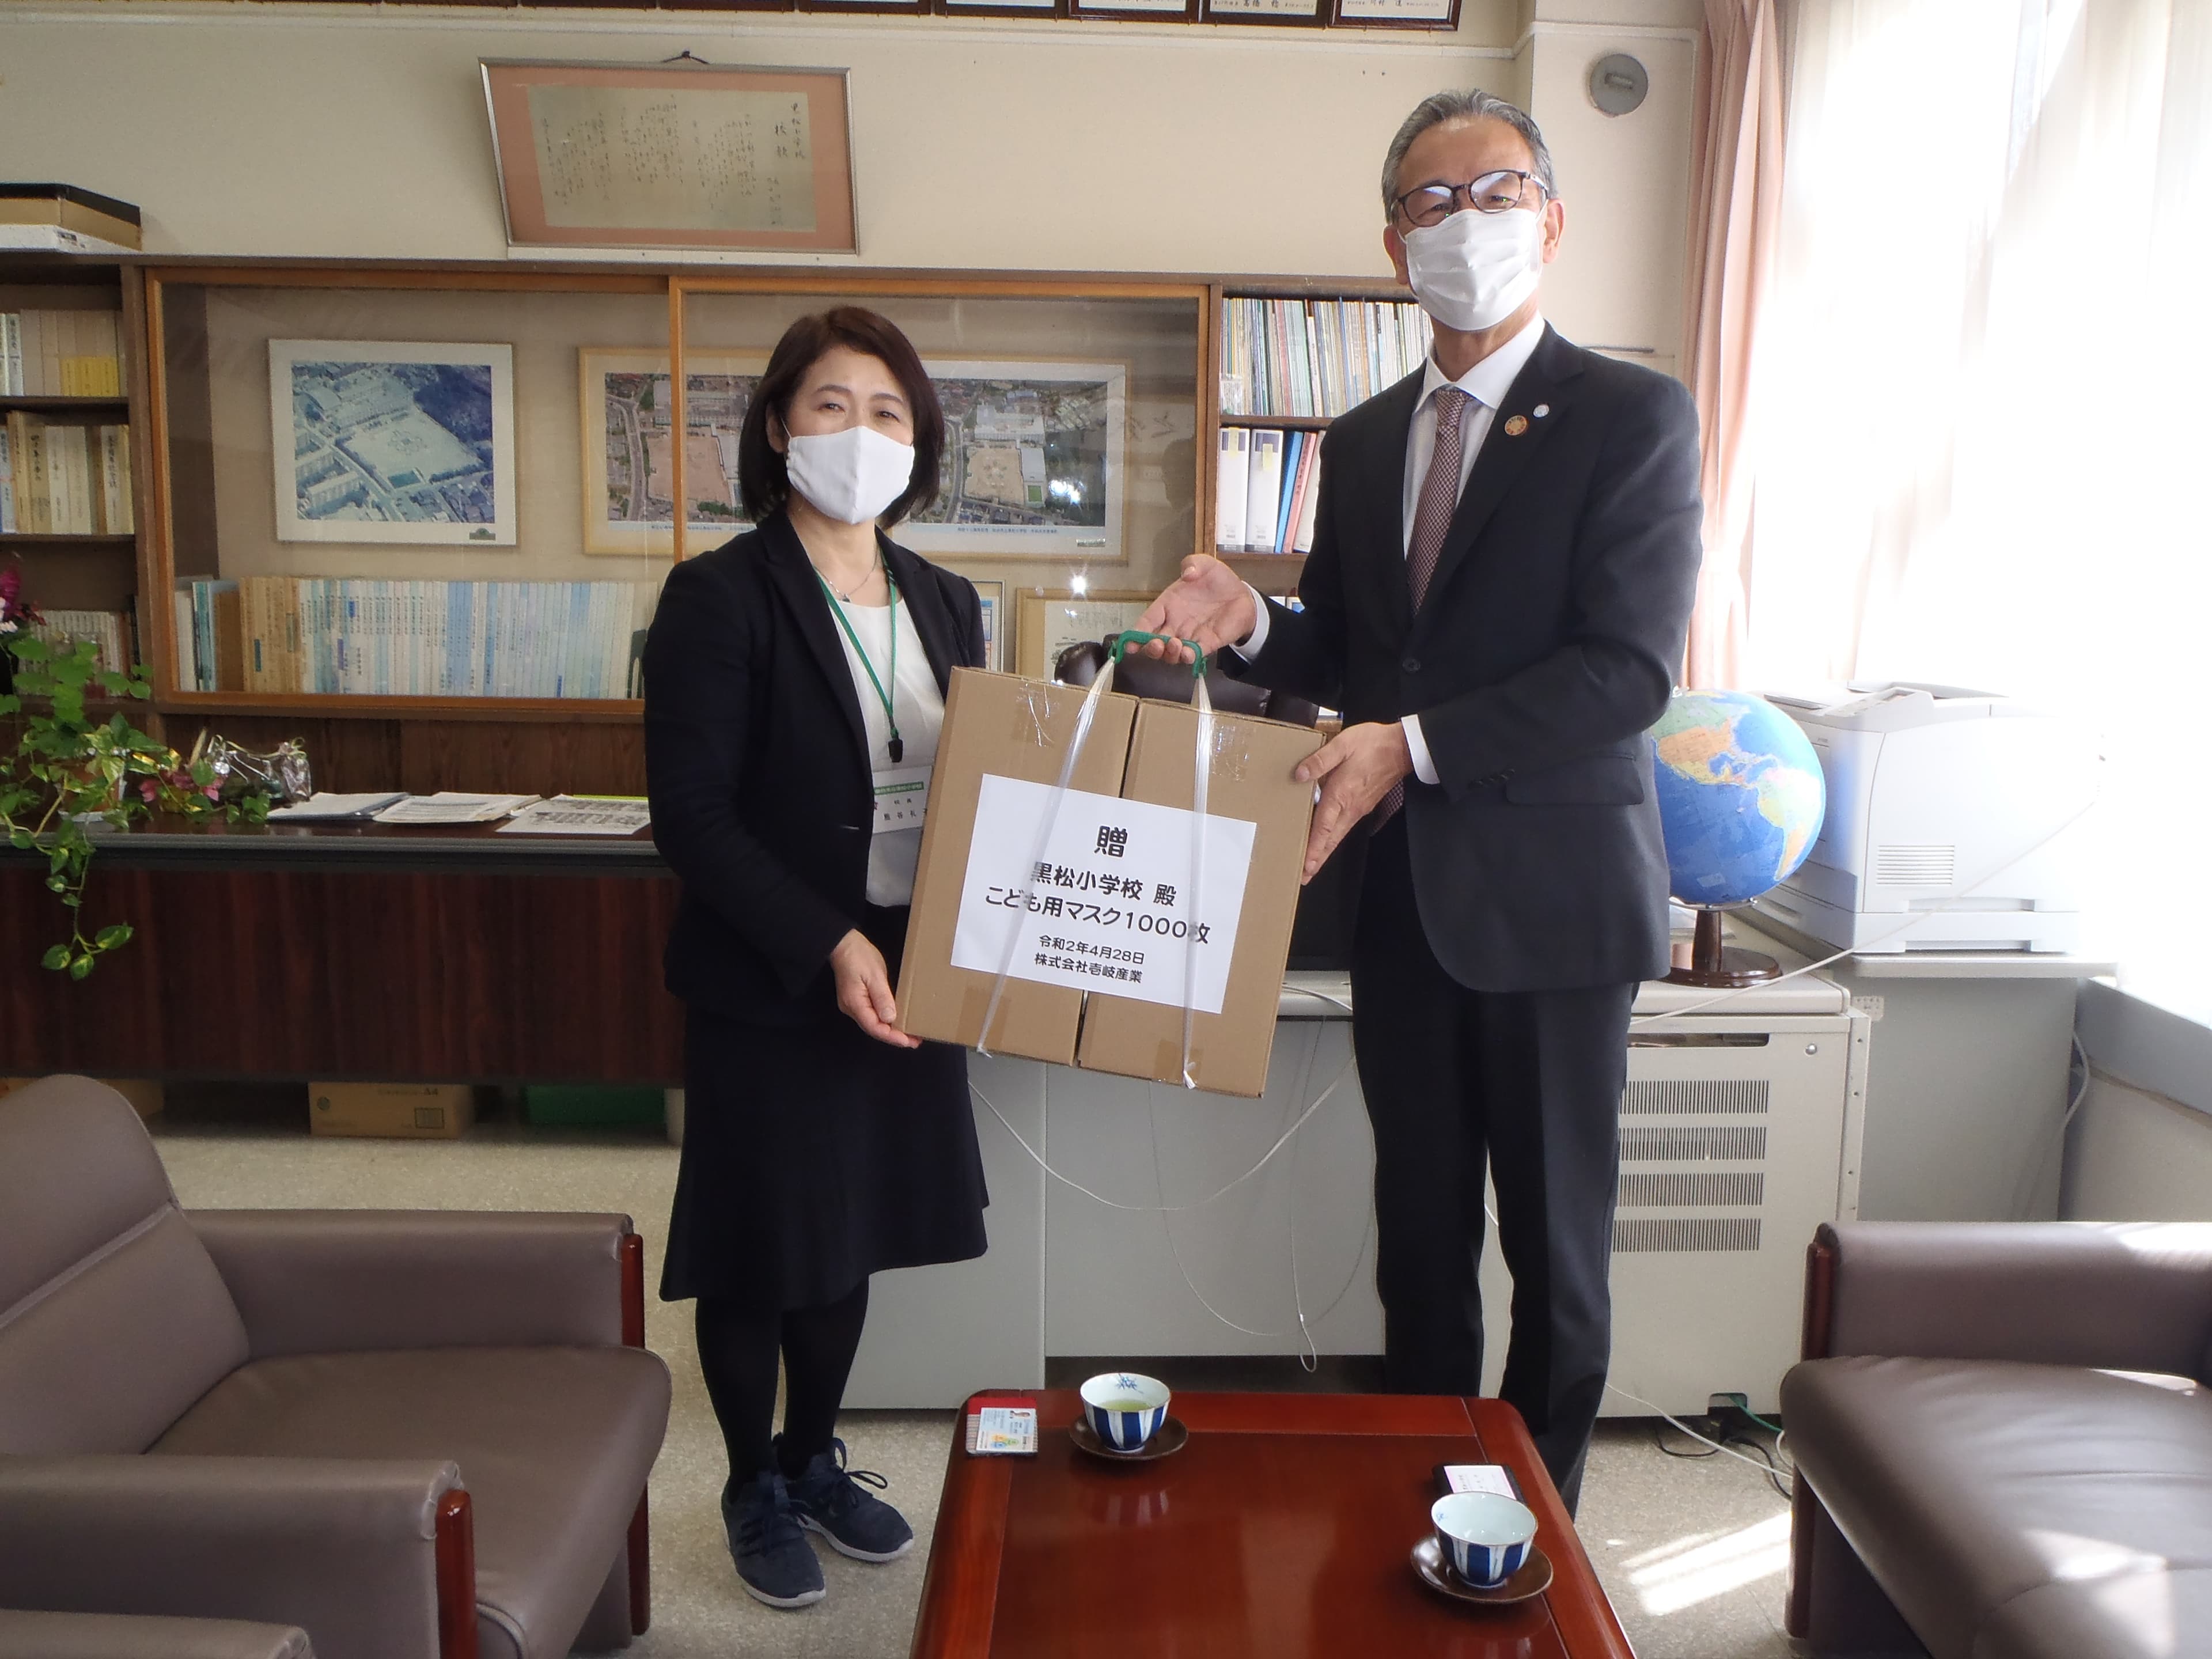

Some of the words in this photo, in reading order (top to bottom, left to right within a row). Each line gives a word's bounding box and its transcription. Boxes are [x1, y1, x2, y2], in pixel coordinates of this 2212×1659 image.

[1094, 825, 1128, 858] 贈
[1031, 861, 1143, 900] 黒松小学校
[1153, 884, 1177, 907] 殿
[1039, 934, 1145, 965] 令和2年4月28日
[1033, 952, 1143, 984] 株式会社壱岐産業
